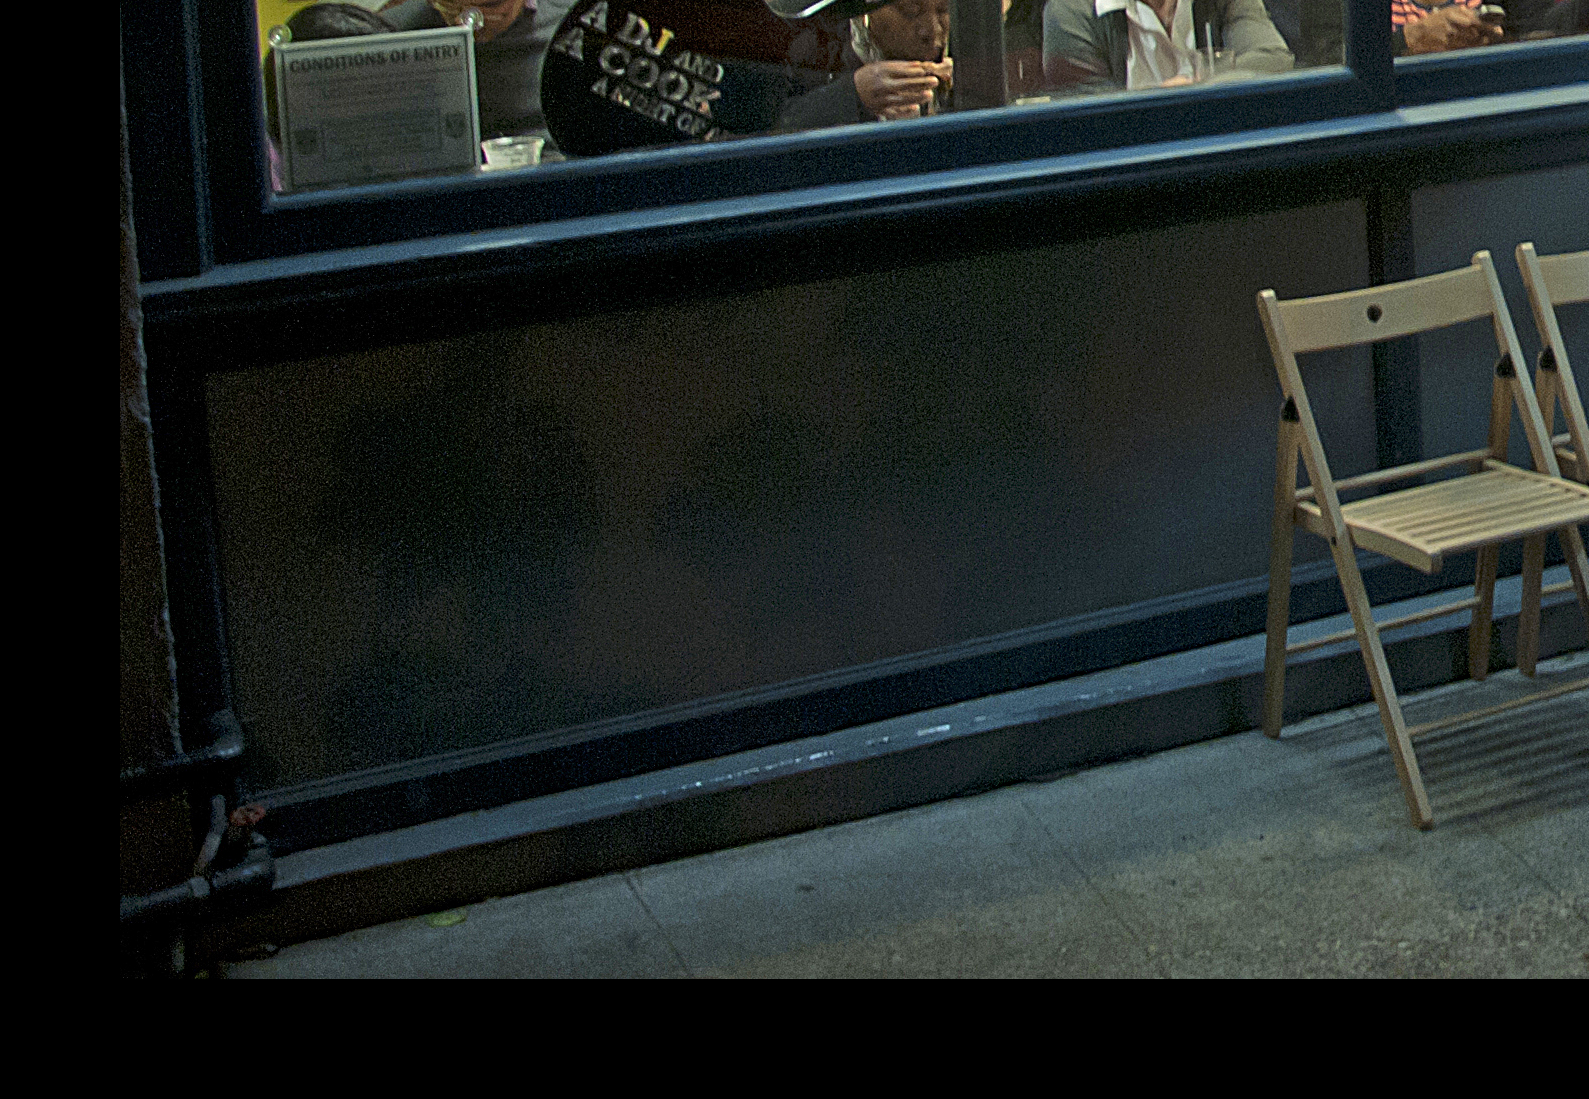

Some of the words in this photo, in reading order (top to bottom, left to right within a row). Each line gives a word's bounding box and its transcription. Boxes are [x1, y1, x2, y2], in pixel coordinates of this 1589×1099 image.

[289, 51, 388, 73] CONDITIONS
[390, 49, 407, 63] OF
[413, 44, 460, 62] ENTRY
[580, 0, 609, 33] A
[615, 11, 675, 57] DJ
[673, 50, 725, 84] AND
[599, 44, 722, 119] COOK
